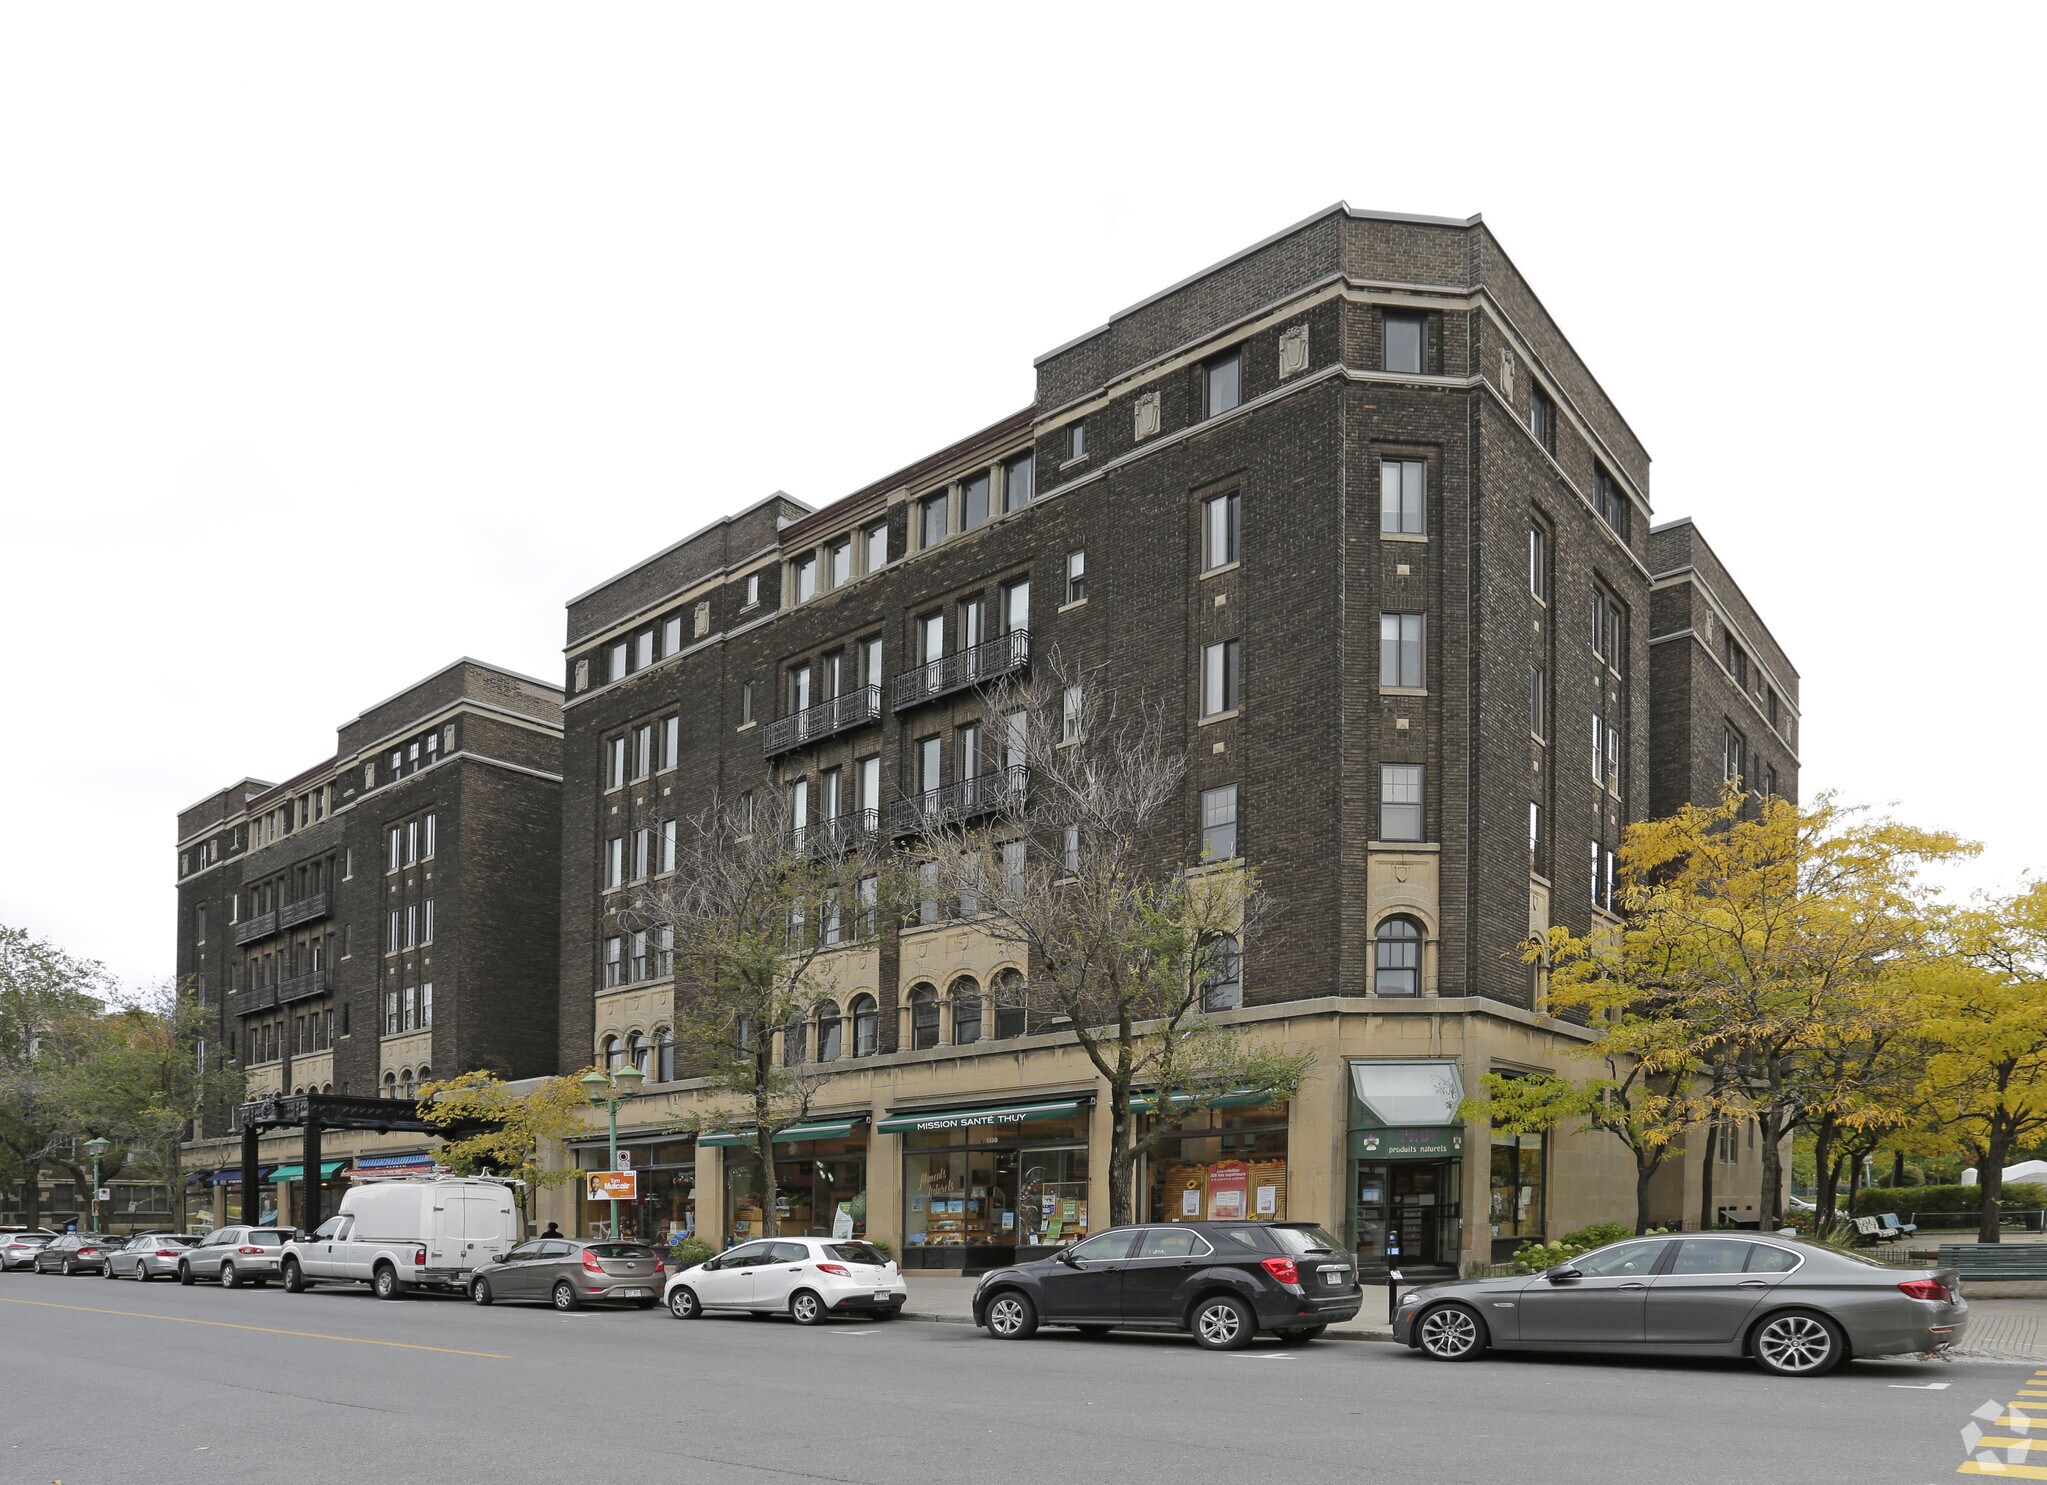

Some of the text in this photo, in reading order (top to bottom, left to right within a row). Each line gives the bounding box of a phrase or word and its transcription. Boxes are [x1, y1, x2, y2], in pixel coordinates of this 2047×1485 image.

[917, 1113, 1026, 1130] MISSION SANTÉ THUY
[1388, 1146, 1417, 1154] produits
